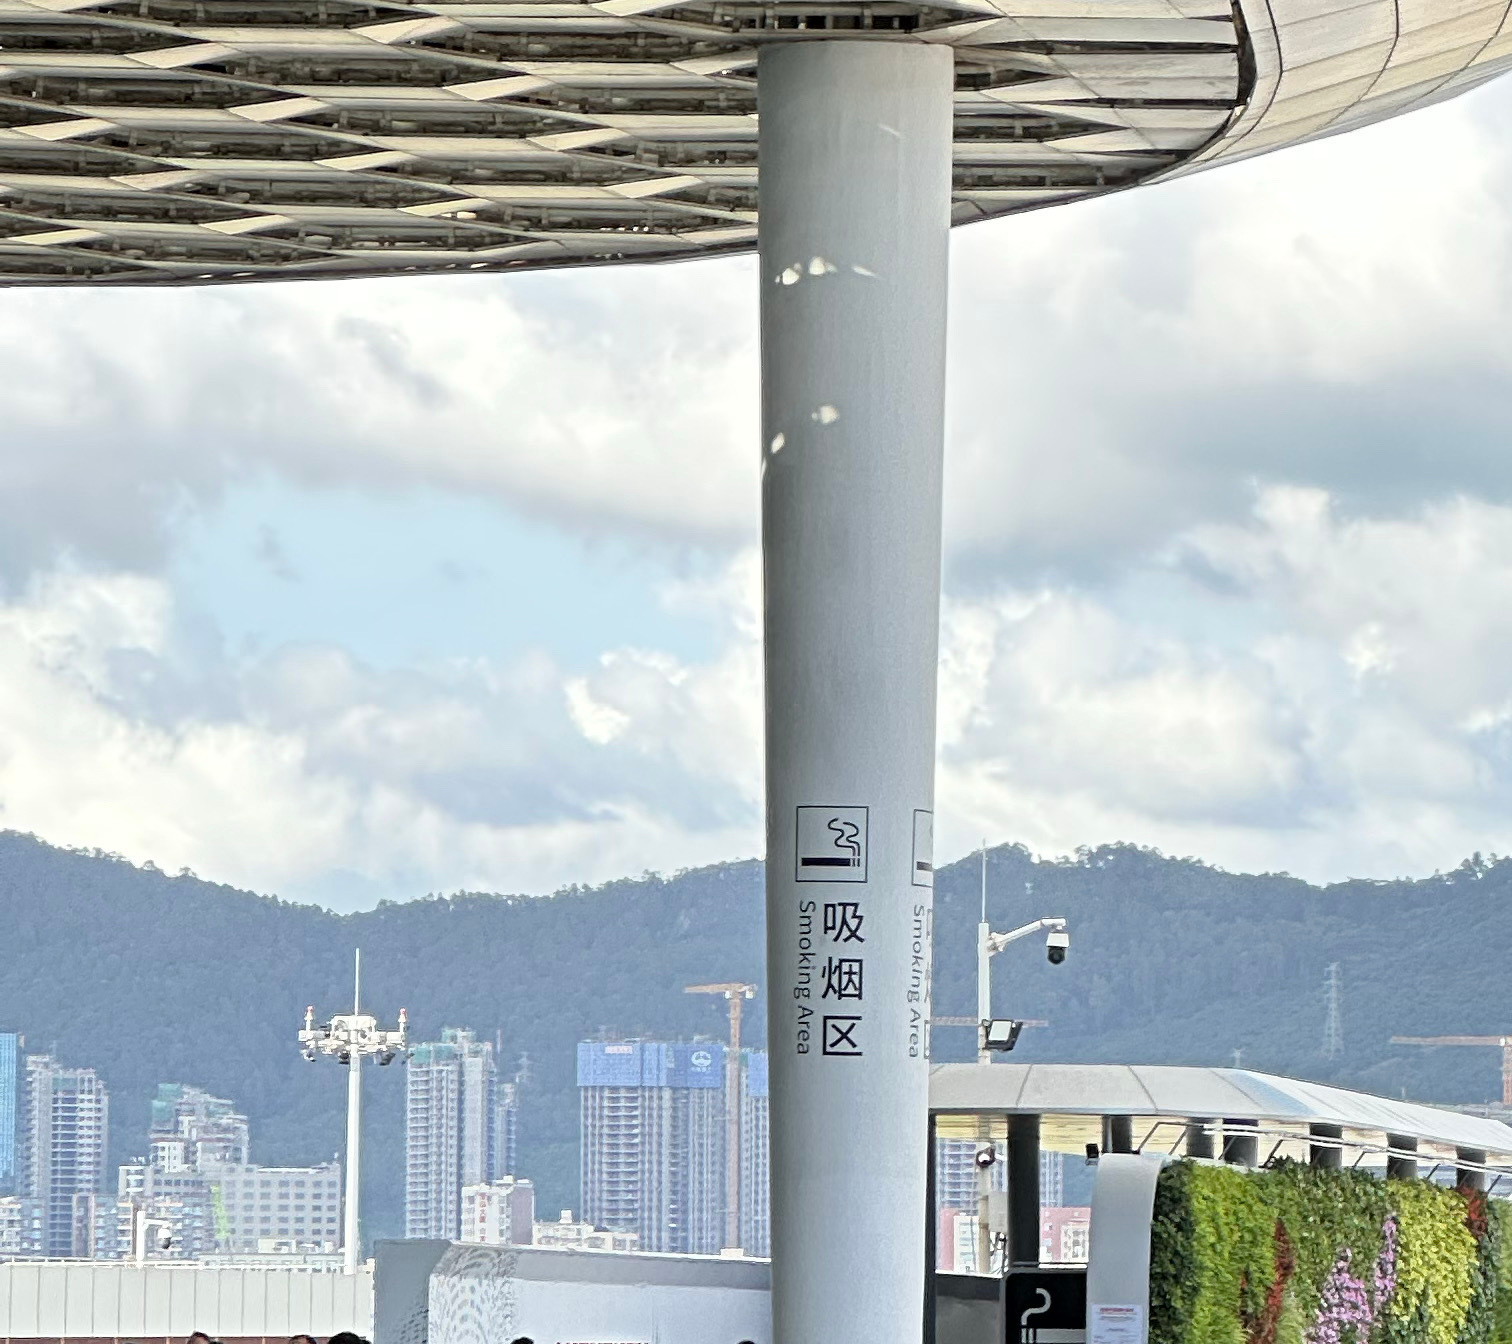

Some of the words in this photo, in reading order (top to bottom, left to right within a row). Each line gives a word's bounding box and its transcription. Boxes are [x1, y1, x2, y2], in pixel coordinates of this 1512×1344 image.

[794, 901, 816, 999] Smoking
[821, 902, 865, 1056] 吸烟区
[907, 905, 925, 1003] Smoking
[797, 1006, 815, 1054] Area
[909, 1008, 921, 1058] Area
